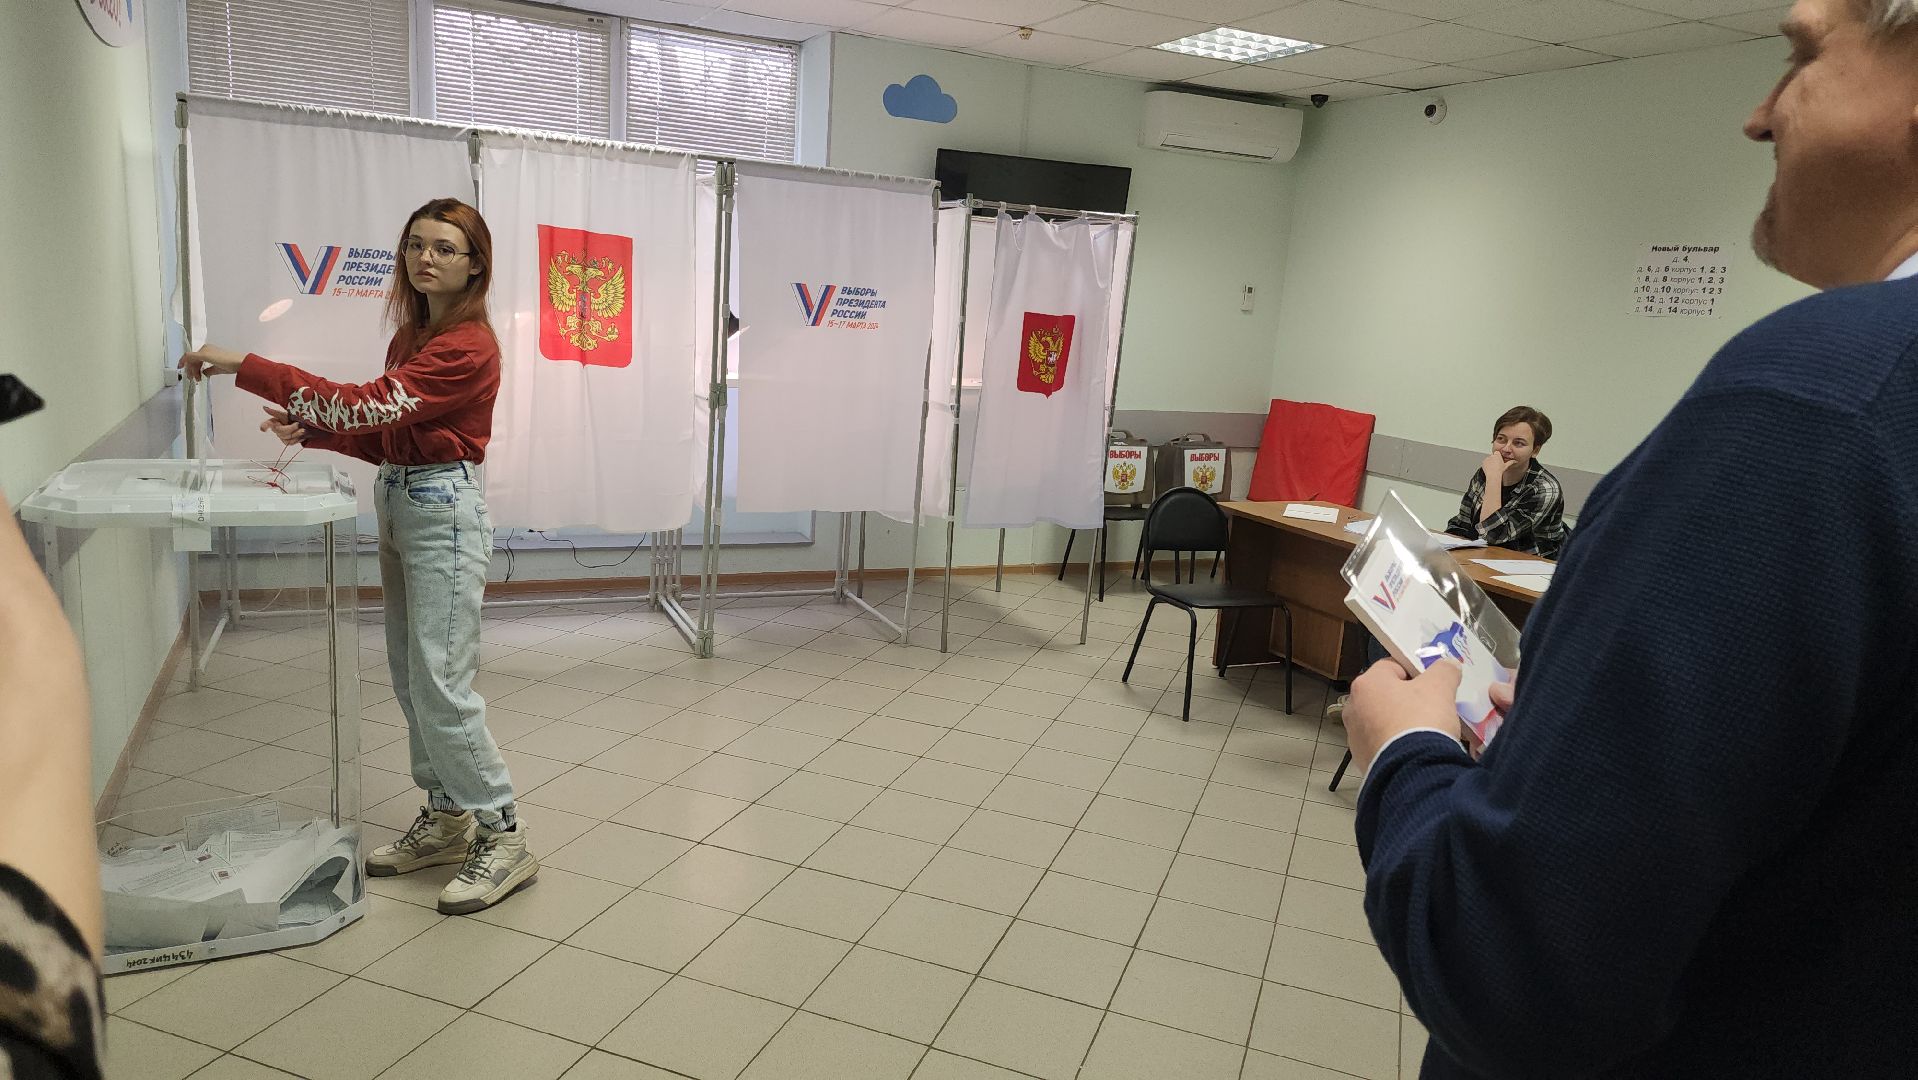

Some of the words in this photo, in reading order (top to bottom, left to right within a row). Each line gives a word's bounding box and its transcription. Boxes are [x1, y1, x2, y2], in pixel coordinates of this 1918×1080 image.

[1651, 244, 1680, 253] Новый
[342, 261, 395, 275] ПРЕЗИДЕ
[1720, 266, 1727, 274] 3
[336, 275, 384, 287] РОССИИ
[1662, 275, 1668, 283] 8
[1670, 277, 1696, 285] корпус
[1718, 276, 1725, 284] 3
[355, 289, 384, 298] МАРТА
[841, 286, 878, 297] ВЫБОРЫ
[836, 298, 887, 309] ПРЕЗИДЕНТА
[1669, 296, 1680, 304] 12
[1681, 298, 1708, 306] корпус
[1709, 298, 1715, 306] 1
[831, 309, 867, 319] РОССИИ
[1667, 306, 1678, 314] 14
[1680, 308, 1706, 317] корпус
[1707, 308, 1713, 316] 1
[846, 321, 866, 329] МАРТА
[1109, 450, 1142, 460] ВЫБОРЫ
[1189, 452, 1220, 462] ВЫБОРЫ
